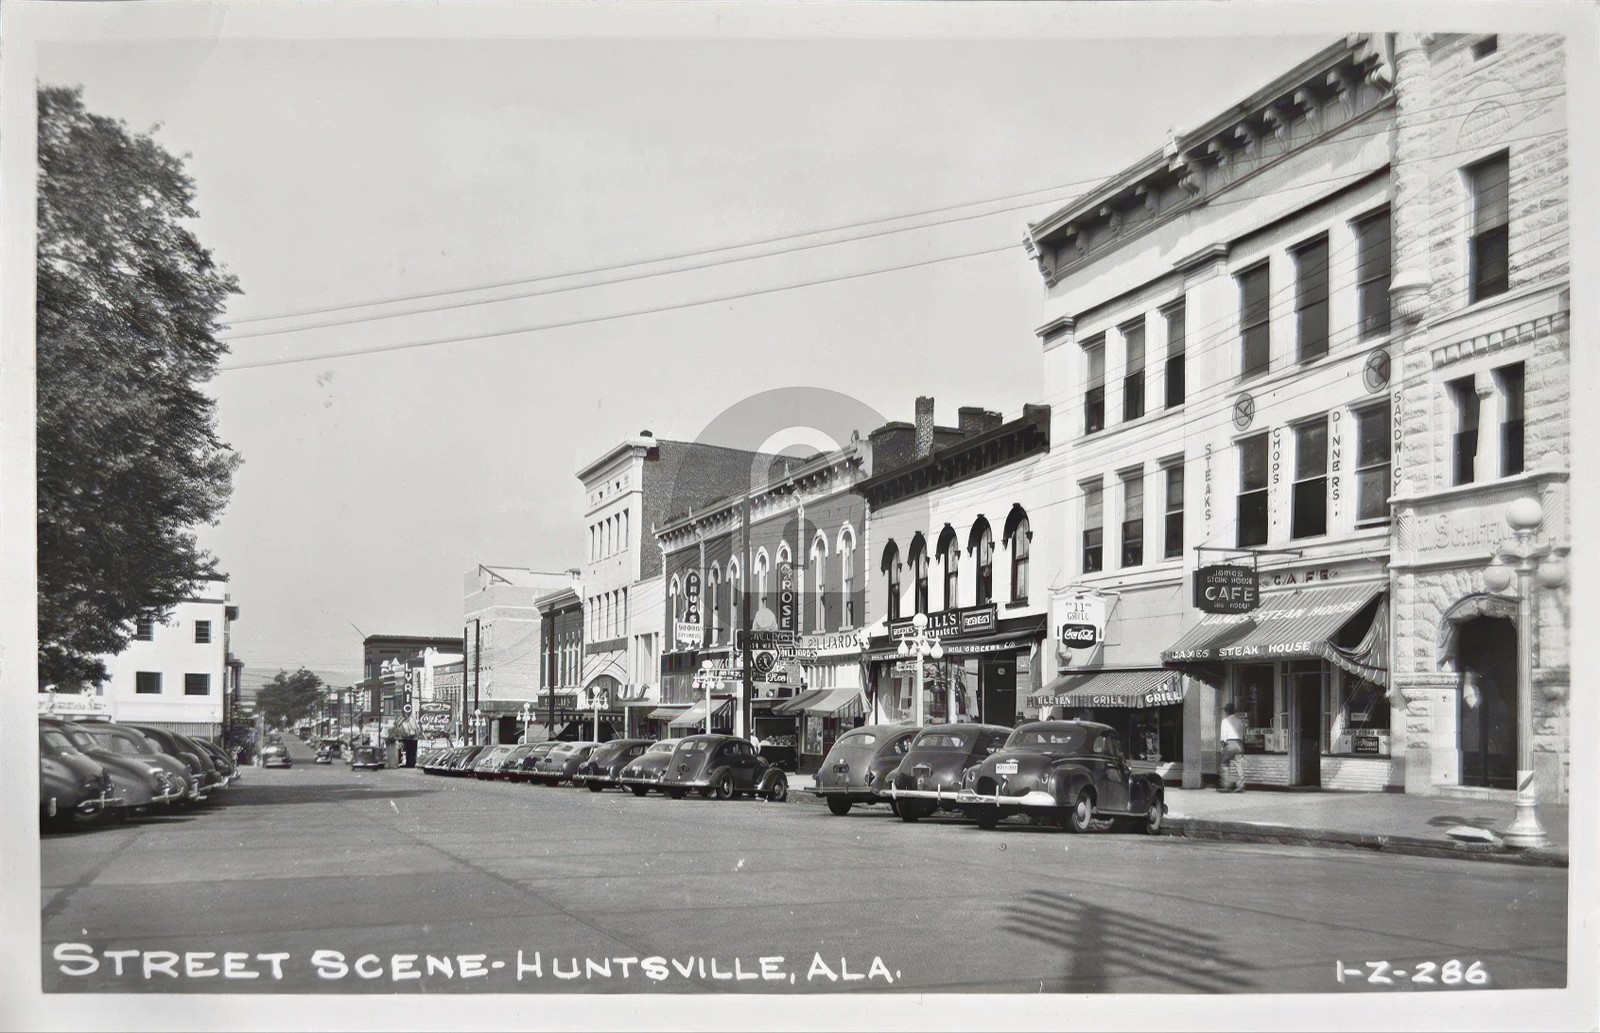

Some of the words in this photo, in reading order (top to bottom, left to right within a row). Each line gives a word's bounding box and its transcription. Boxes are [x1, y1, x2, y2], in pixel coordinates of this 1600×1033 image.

[1271, 427, 1281, 485] CHOPS
[1331, 410, 1341, 501] DINNERS
[1203, 443, 1212, 522] STEAKS
[781, 579, 793, 629] ROSE
[1205, 586, 1254, 602] CAFE
[1217, 645, 1260, 658] STEAK
[1267, 641, 1311, 655] HOUSE
[1144, 691, 1183, 704] GRILL
